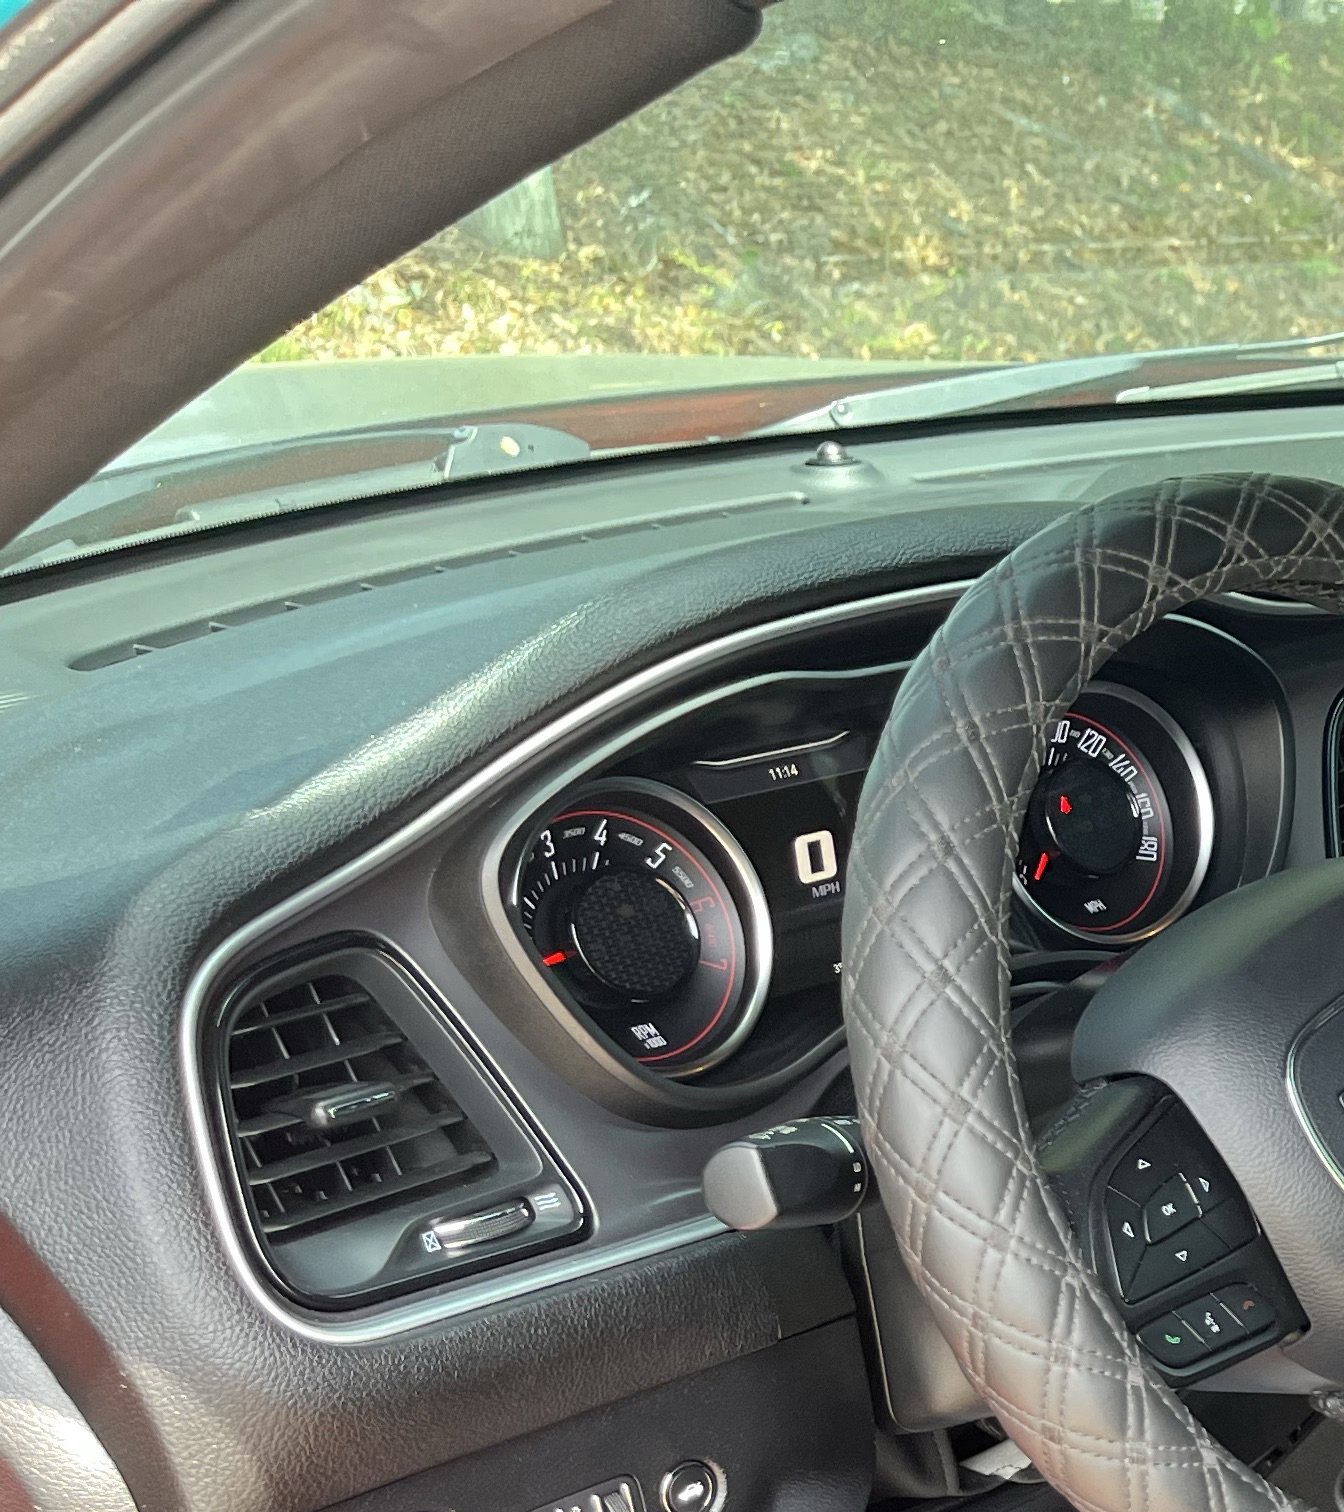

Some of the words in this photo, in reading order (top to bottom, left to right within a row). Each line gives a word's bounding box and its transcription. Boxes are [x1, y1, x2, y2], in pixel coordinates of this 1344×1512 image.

[1077, 728, 1107, 758] 120
[1108, 753, 1138, 782] 140
[541, 830, 555, 857] 3
[594, 819, 607, 846] 4
[646, 842, 672, 869] 5
[795, 830, 838, 884] 0
[1136, 836, 1158, 861] 180
[812, 882, 840, 899] MPH
[631, 1022, 660, 1041] RPM
[1161, 1203, 1177, 1216] OK
